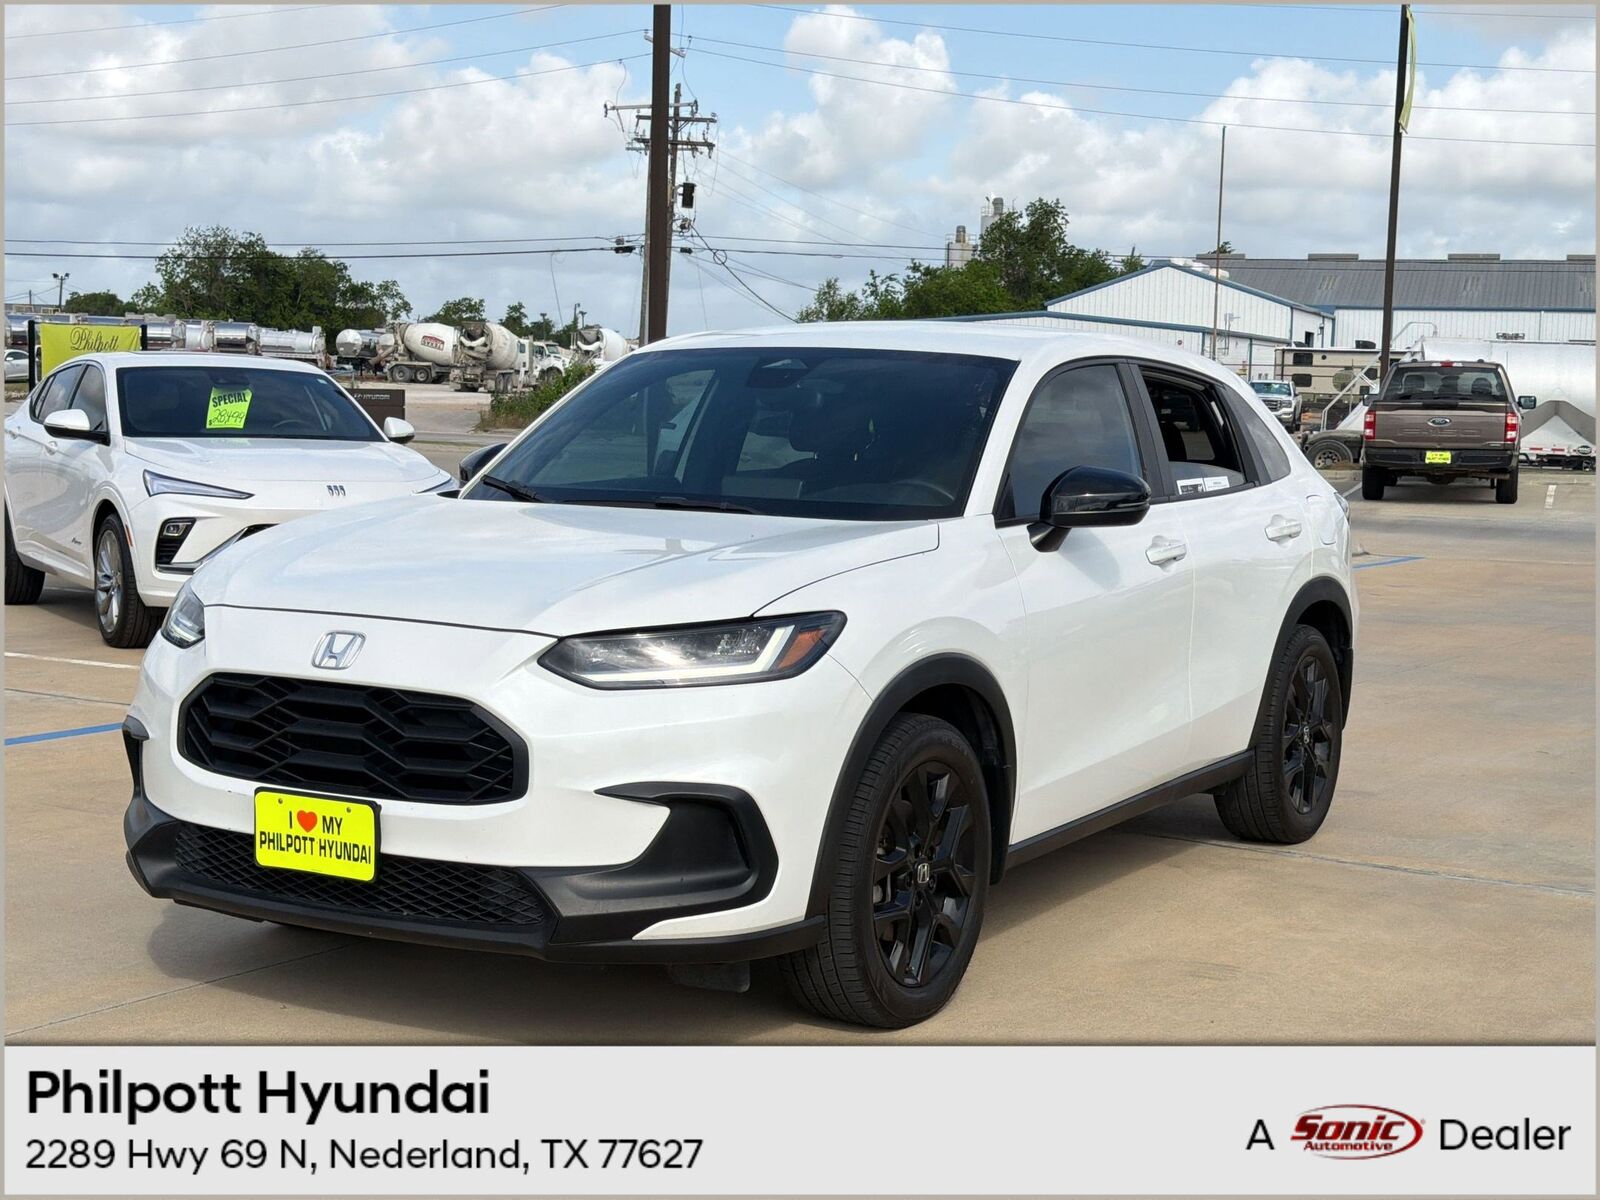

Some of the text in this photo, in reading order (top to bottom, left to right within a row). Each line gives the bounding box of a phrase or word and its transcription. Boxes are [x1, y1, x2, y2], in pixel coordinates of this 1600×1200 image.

[70, 327, 119, 352] Philpott
[212, 392, 249, 408] SPECIAL
[288, 810, 343, 836] I MY
[259, 831, 371, 865] PHILPOTT HYUNDAI
